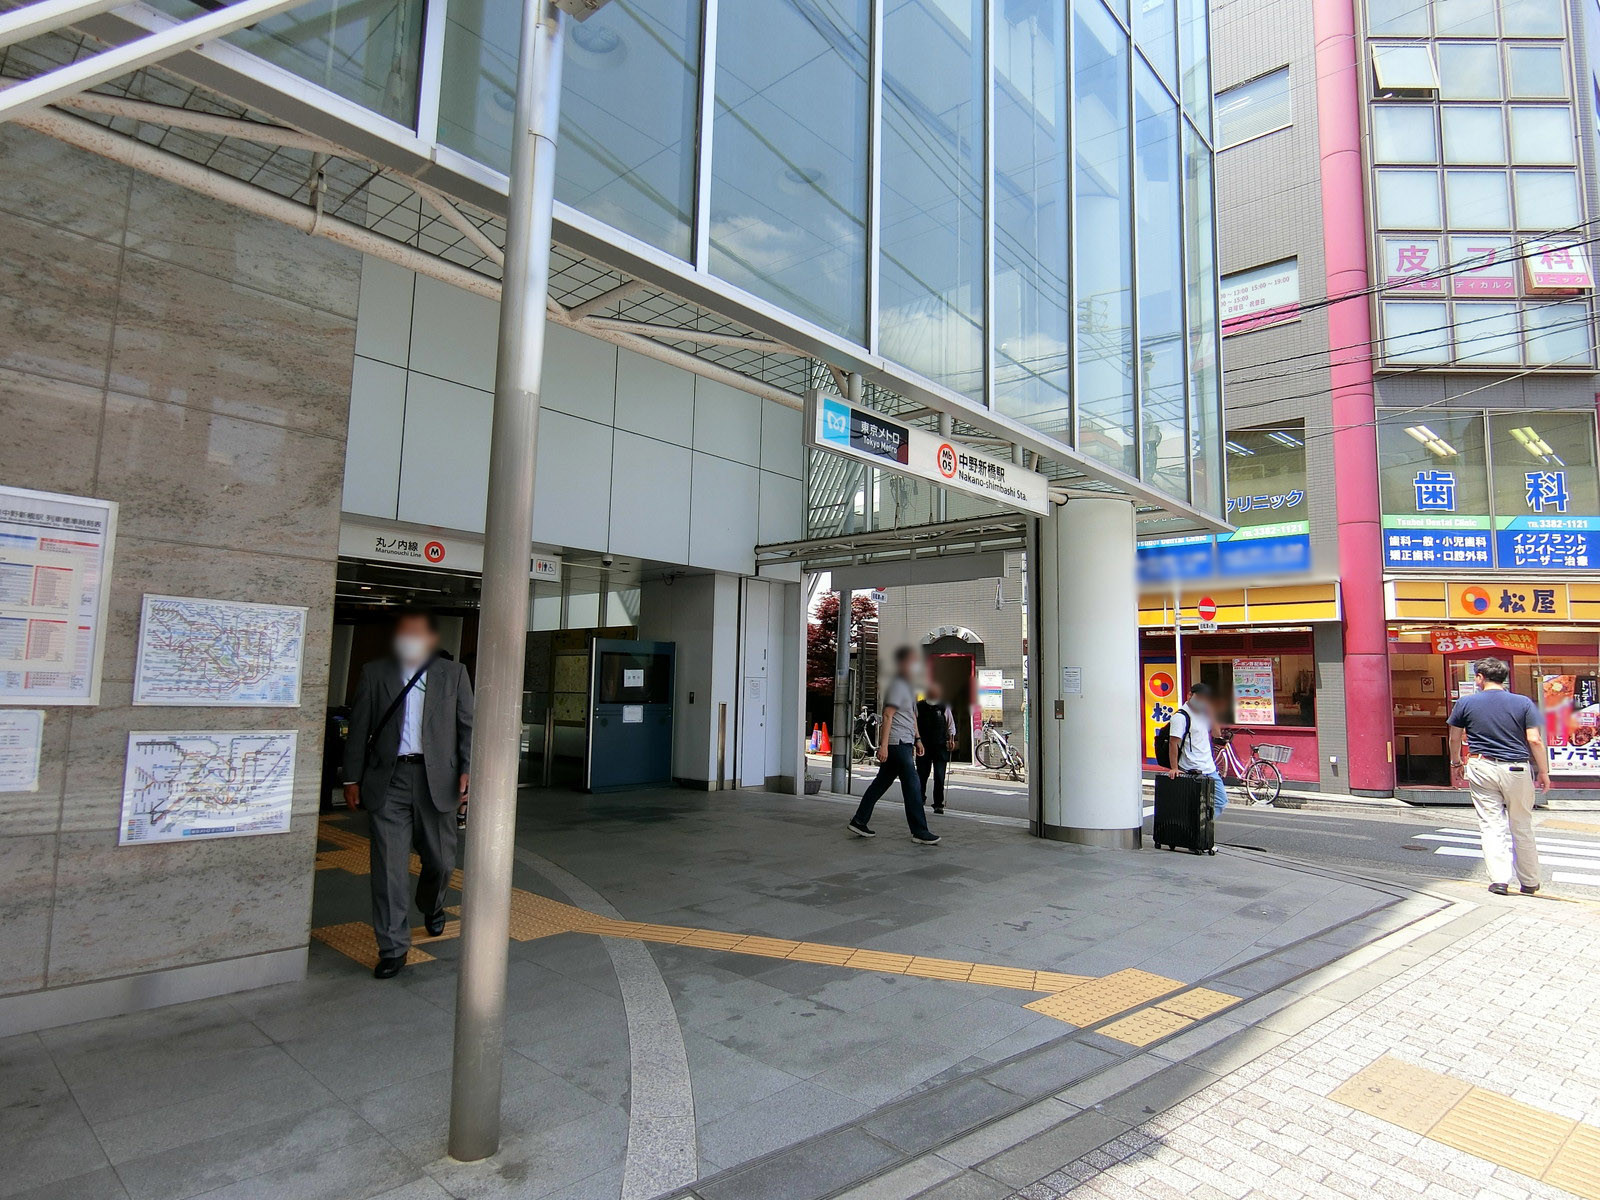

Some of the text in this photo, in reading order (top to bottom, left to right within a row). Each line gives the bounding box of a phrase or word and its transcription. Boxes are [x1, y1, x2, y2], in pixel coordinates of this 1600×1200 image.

[1396, 245, 1430, 273] 皮
[861, 420, 900, 445] 東京メトロ
[863, 435, 897, 454] Tokyo Metro
[942, 450, 952, 460] Mb
[942, 460, 952, 471] 05
[958, 453, 1005, 483] 中野新橋駅
[958, 470, 1028, 501] Nakano-shimbashi Sta.
[1413, 470, 1569, 513] 歯 科
[1425, 518, 1453, 527] Dental
[1454, 518, 1477, 527] Clinic
[1539, 519, 1588, 529] 3382-1121
[1253, 523, 1303, 537] 3382-1121
[376, 536, 419, 552] 丸ノ内線
[1389, 536, 1487, 548] 歯科一般・小児歯科
[1513, 533, 1587, 544] インプラント
[375, 547, 409, 556] Marunouchi
[1389, 550, 1488, 562] 矯正歯科・口腔外科
[1514, 544, 1587, 555] ホワイトニング
[1515, 555, 1589, 567] レーザー治療
[1498, 588, 1556, 614] 松屋
[1436, 635, 1496, 652] お弁当
